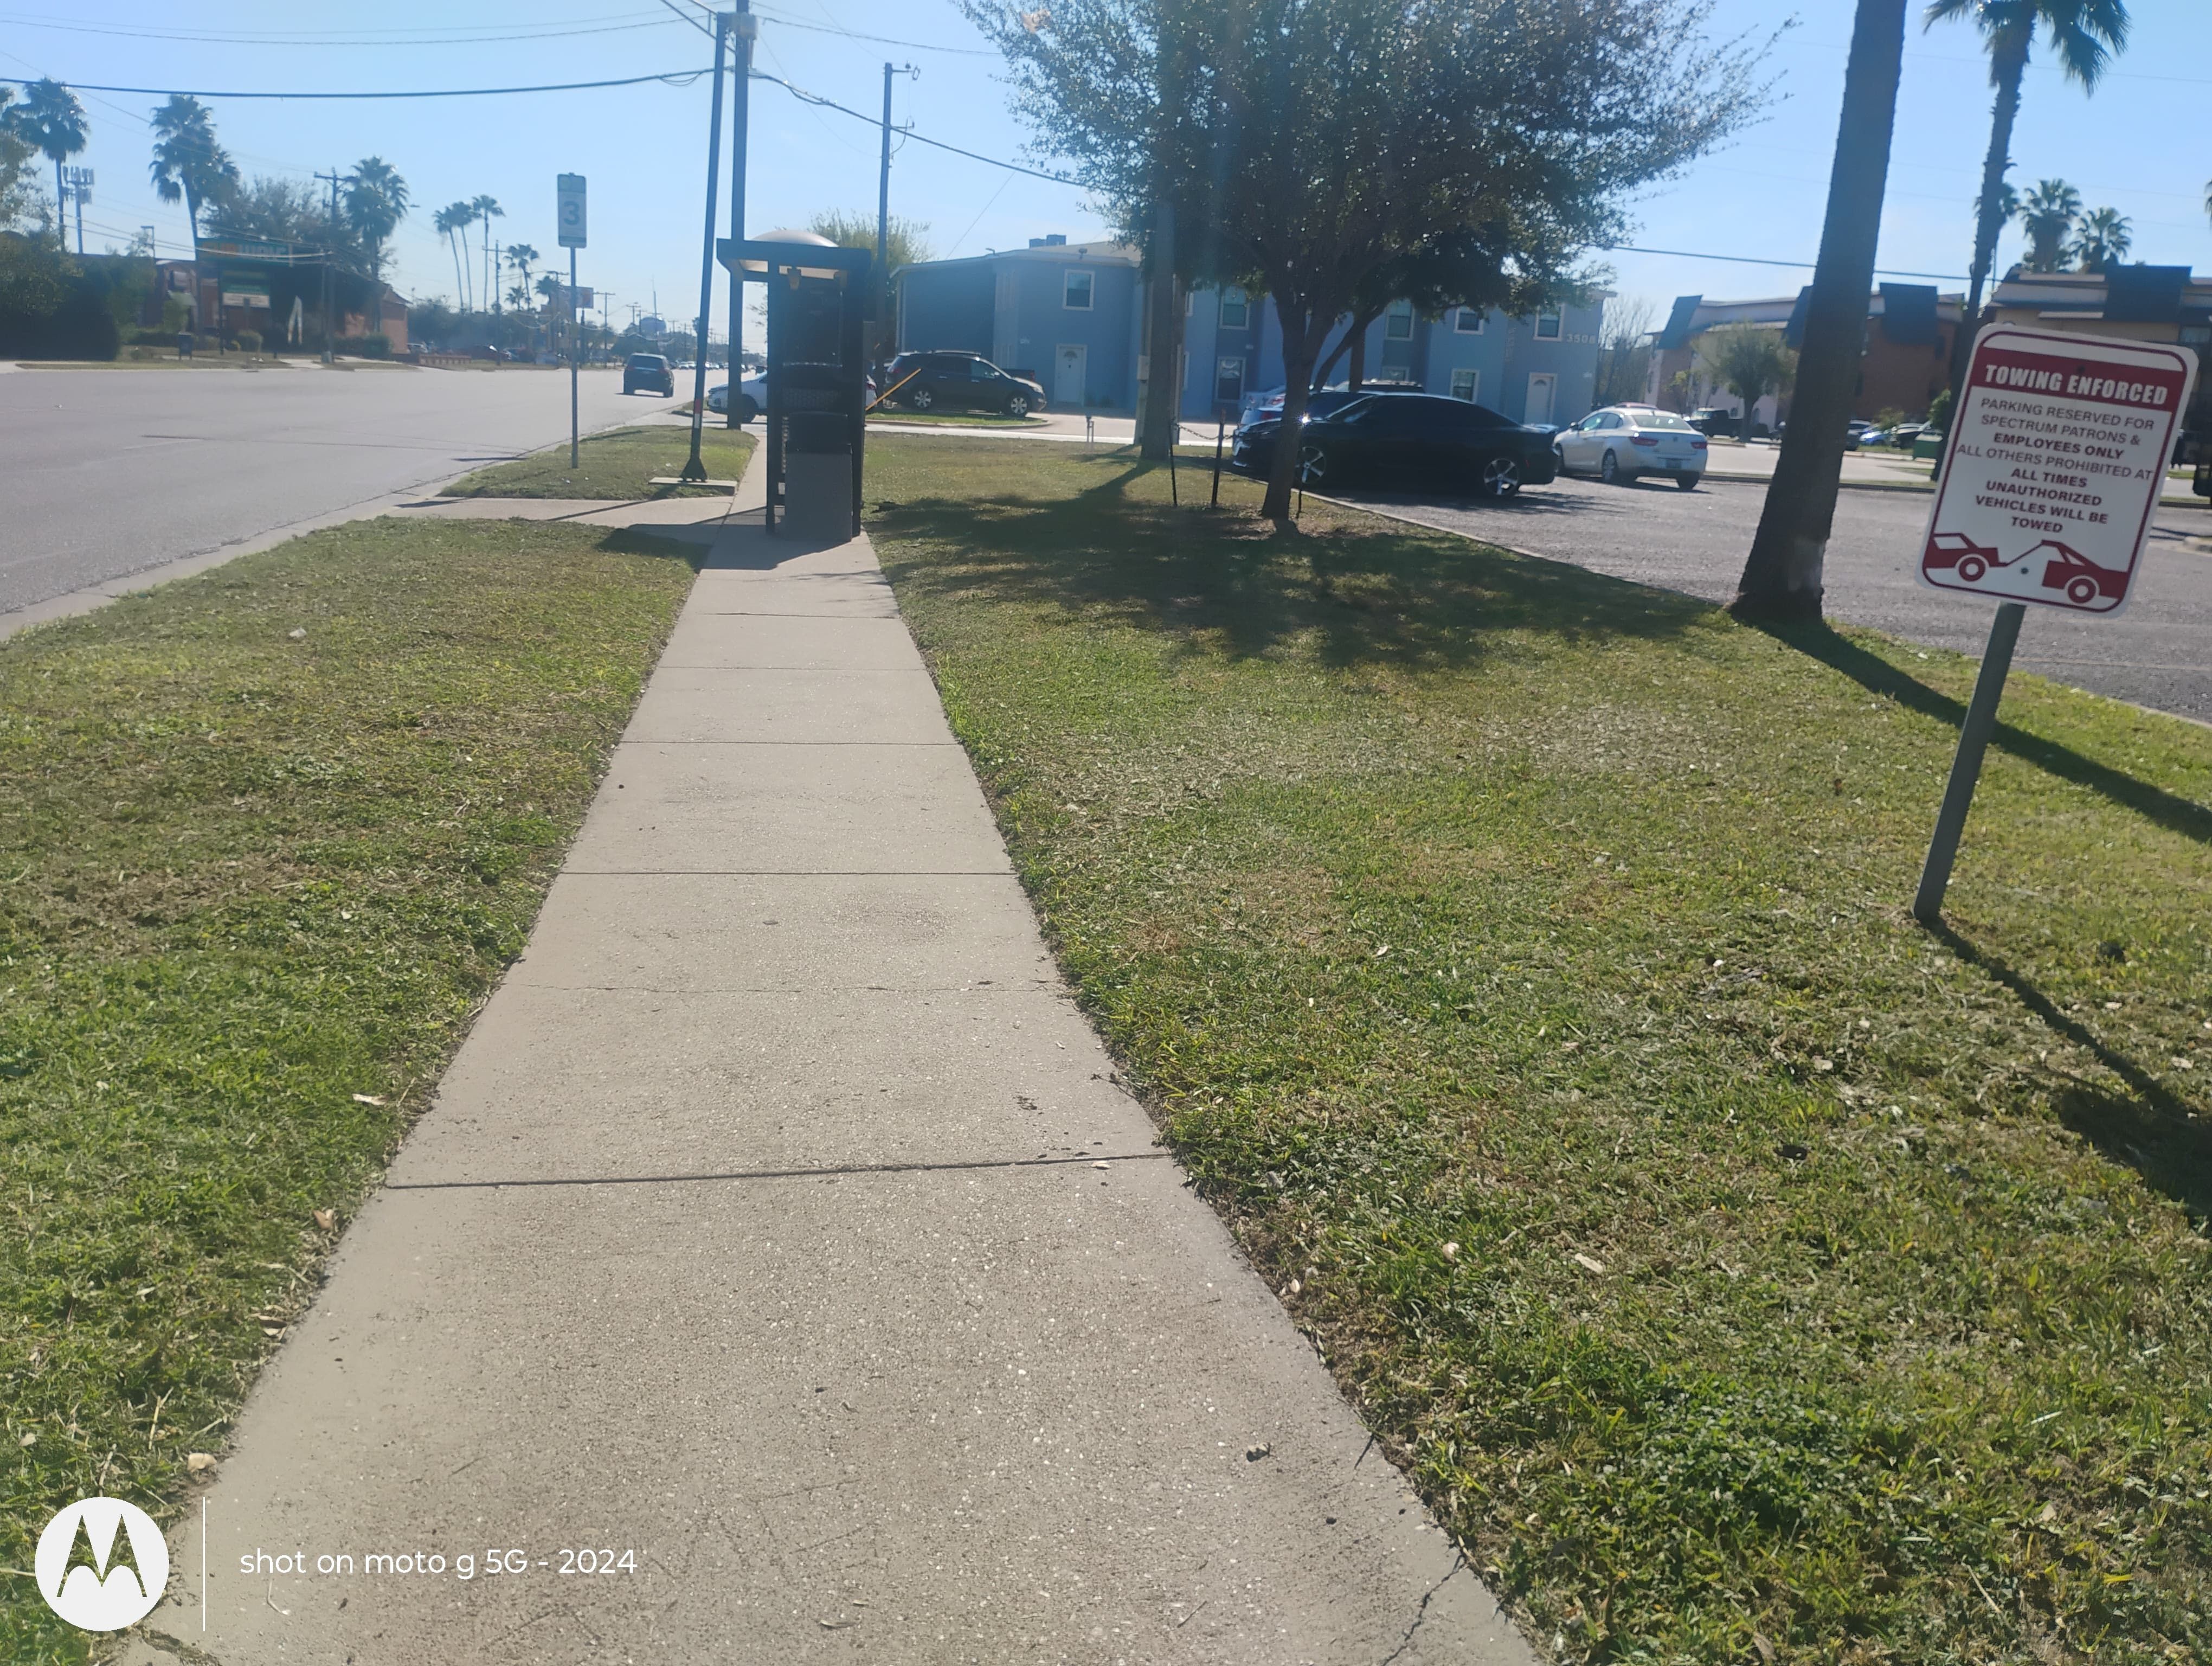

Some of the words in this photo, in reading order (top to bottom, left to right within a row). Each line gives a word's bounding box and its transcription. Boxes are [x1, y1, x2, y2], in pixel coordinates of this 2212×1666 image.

[563, 200, 581, 226] 3
[1985, 364, 2062, 391] TOWING
[2067, 375, 2168, 404] ENFORCED
[1981, 398, 2042, 415] PARKING
[2047, 407, 2121, 425] RESERVED
[2124, 418, 2154, 430] FOR
[1982, 415, 2057, 433] SPECTRUM
[2061, 425, 2126, 443] PATRONS
[2130, 435, 2140, 445] &
[1994, 433, 2081, 453] EMPLOYEES
[2085, 445, 2124, 459] ONLY
[1956, 443, 1981, 457] ALL
[1986, 448, 2042, 465] OTHERS
[2046, 457, 2131, 477] PROHIBITED
[2134, 469, 2153, 482] AT
[2011, 469, 2037, 480] ALL
[2043, 472, 2087, 488] TIMES
[1986, 480, 2102, 506] UNAUTHORIZED
[1976, 495, 2046, 514] VEHICLES
[2050, 506, 2084, 520] WILL
[2088, 512, 2108, 524] BE
[2012, 516, 2063, 533] TOWED
